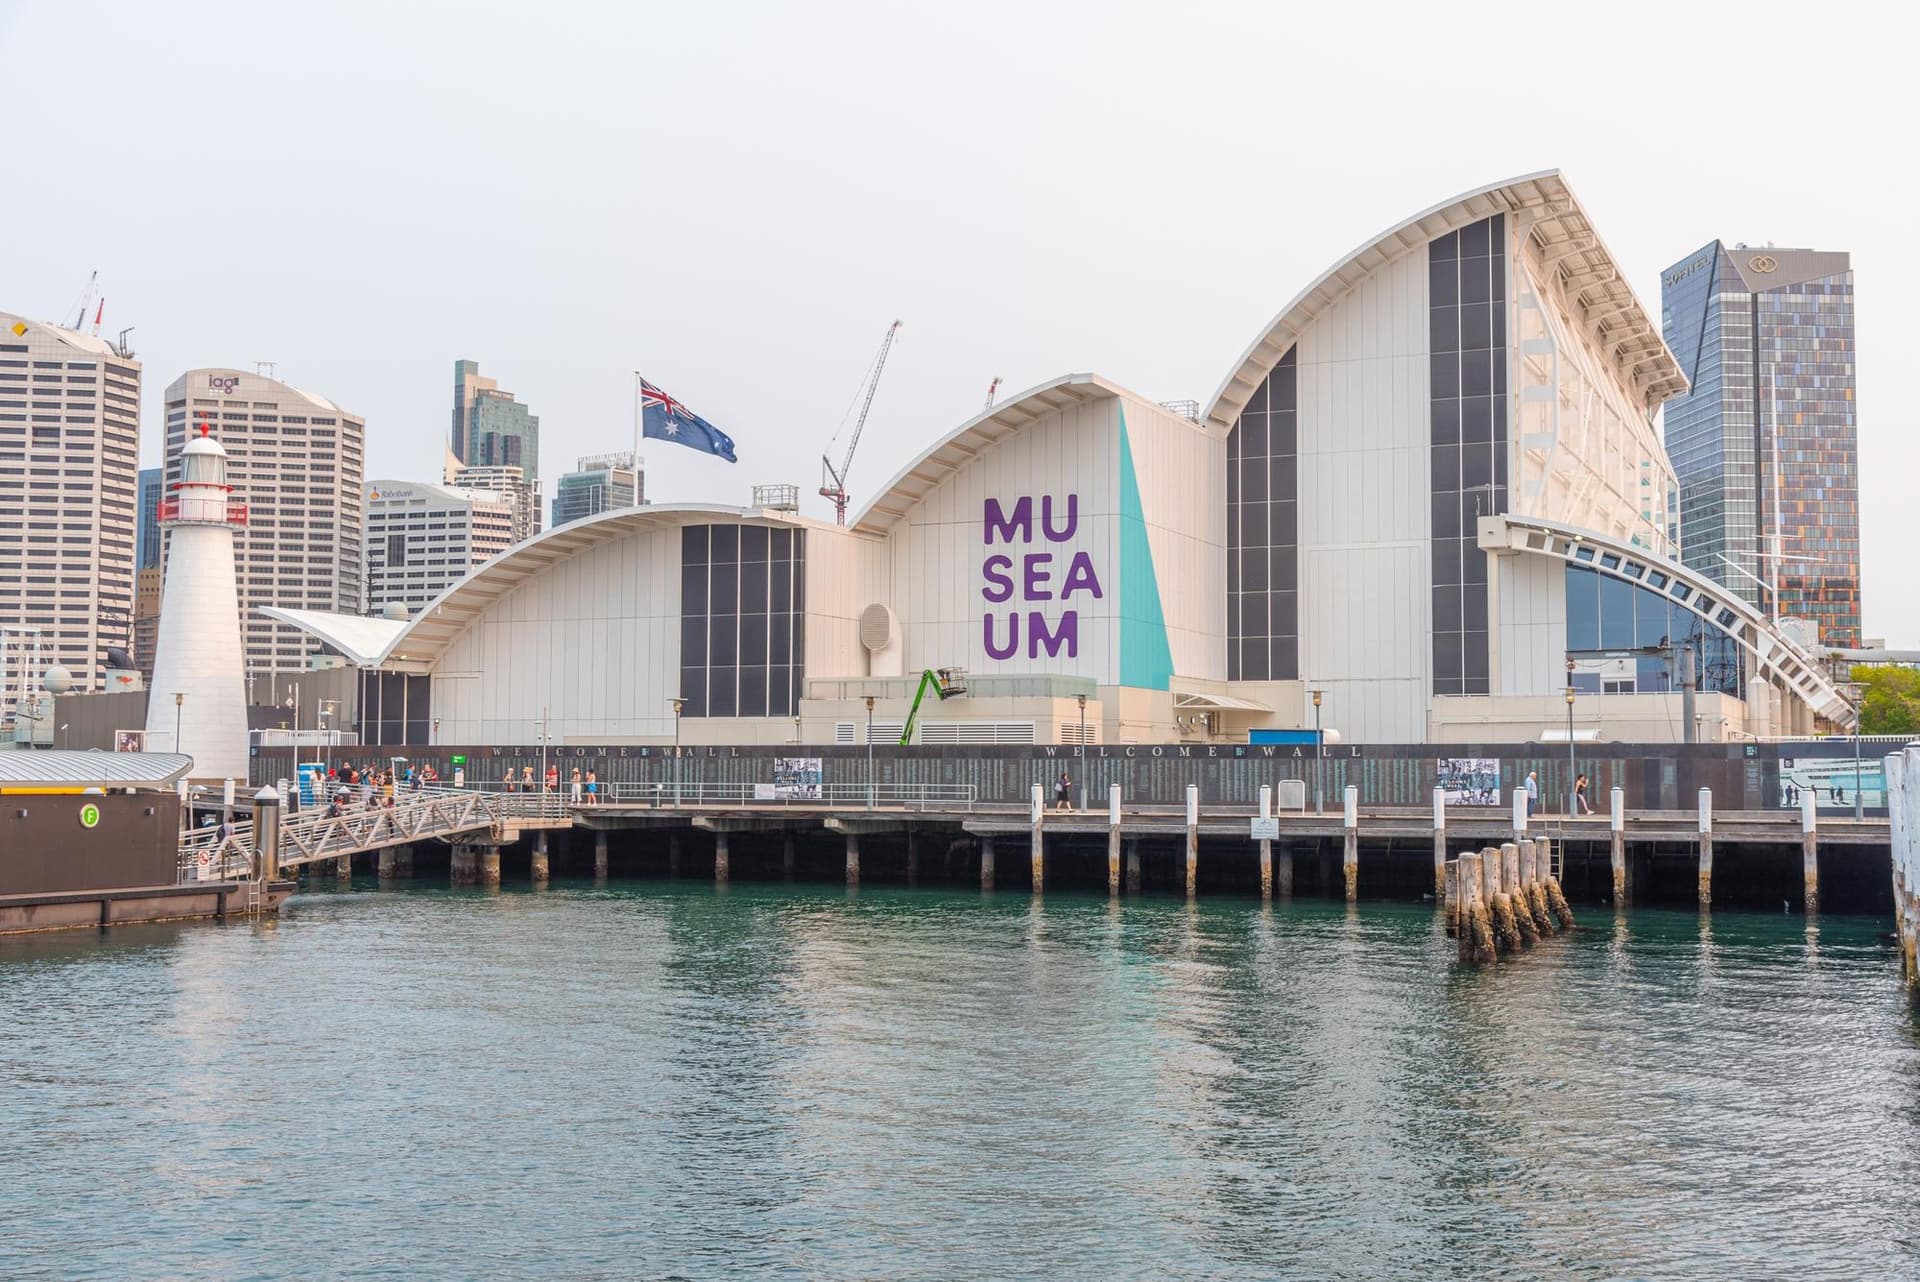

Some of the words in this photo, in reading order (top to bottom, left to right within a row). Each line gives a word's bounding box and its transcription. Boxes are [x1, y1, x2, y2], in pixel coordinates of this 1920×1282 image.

[1665, 255, 1711, 287] SOFITEL
[208, 374, 234, 395] iag
[983, 493, 1078, 545] MU
[981, 551, 1103, 603] SEA
[983, 610, 1078, 660] UM
[492, 747, 629, 757] WELCOME
[662, 747, 739, 757] WALL
[1045, 746, 1217, 757] WELCOME
[1262, 746, 1361, 757] WALL
